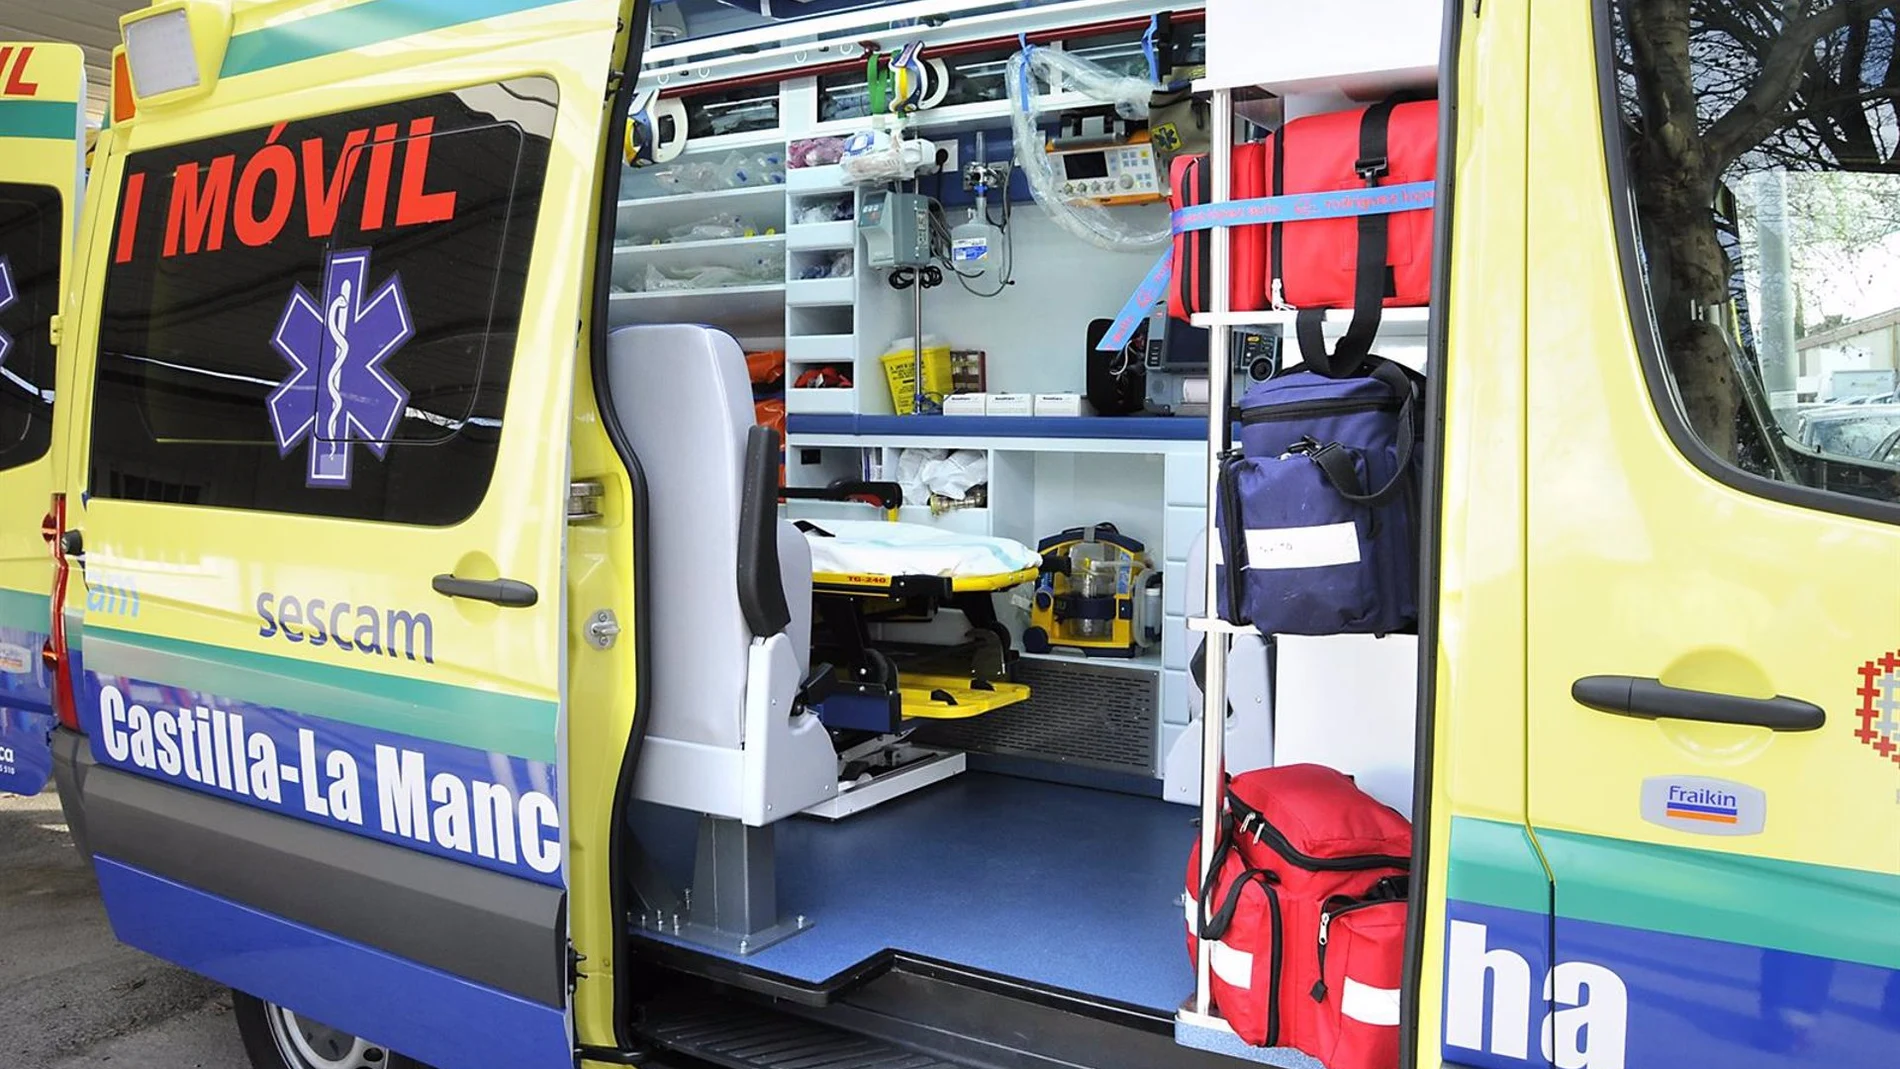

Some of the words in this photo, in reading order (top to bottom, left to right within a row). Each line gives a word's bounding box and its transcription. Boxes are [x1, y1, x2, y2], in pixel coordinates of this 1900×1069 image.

[115, 172, 145, 264] I
[162, 116, 457, 258] MÓVIL
[256, 590, 435, 664] sescam
[99, 684, 364, 826] Castilla-La
[374, 743, 562, 874] Manc
[1669, 784, 1737, 807] Fraikin
[1445, 918, 1628, 1069] ha
